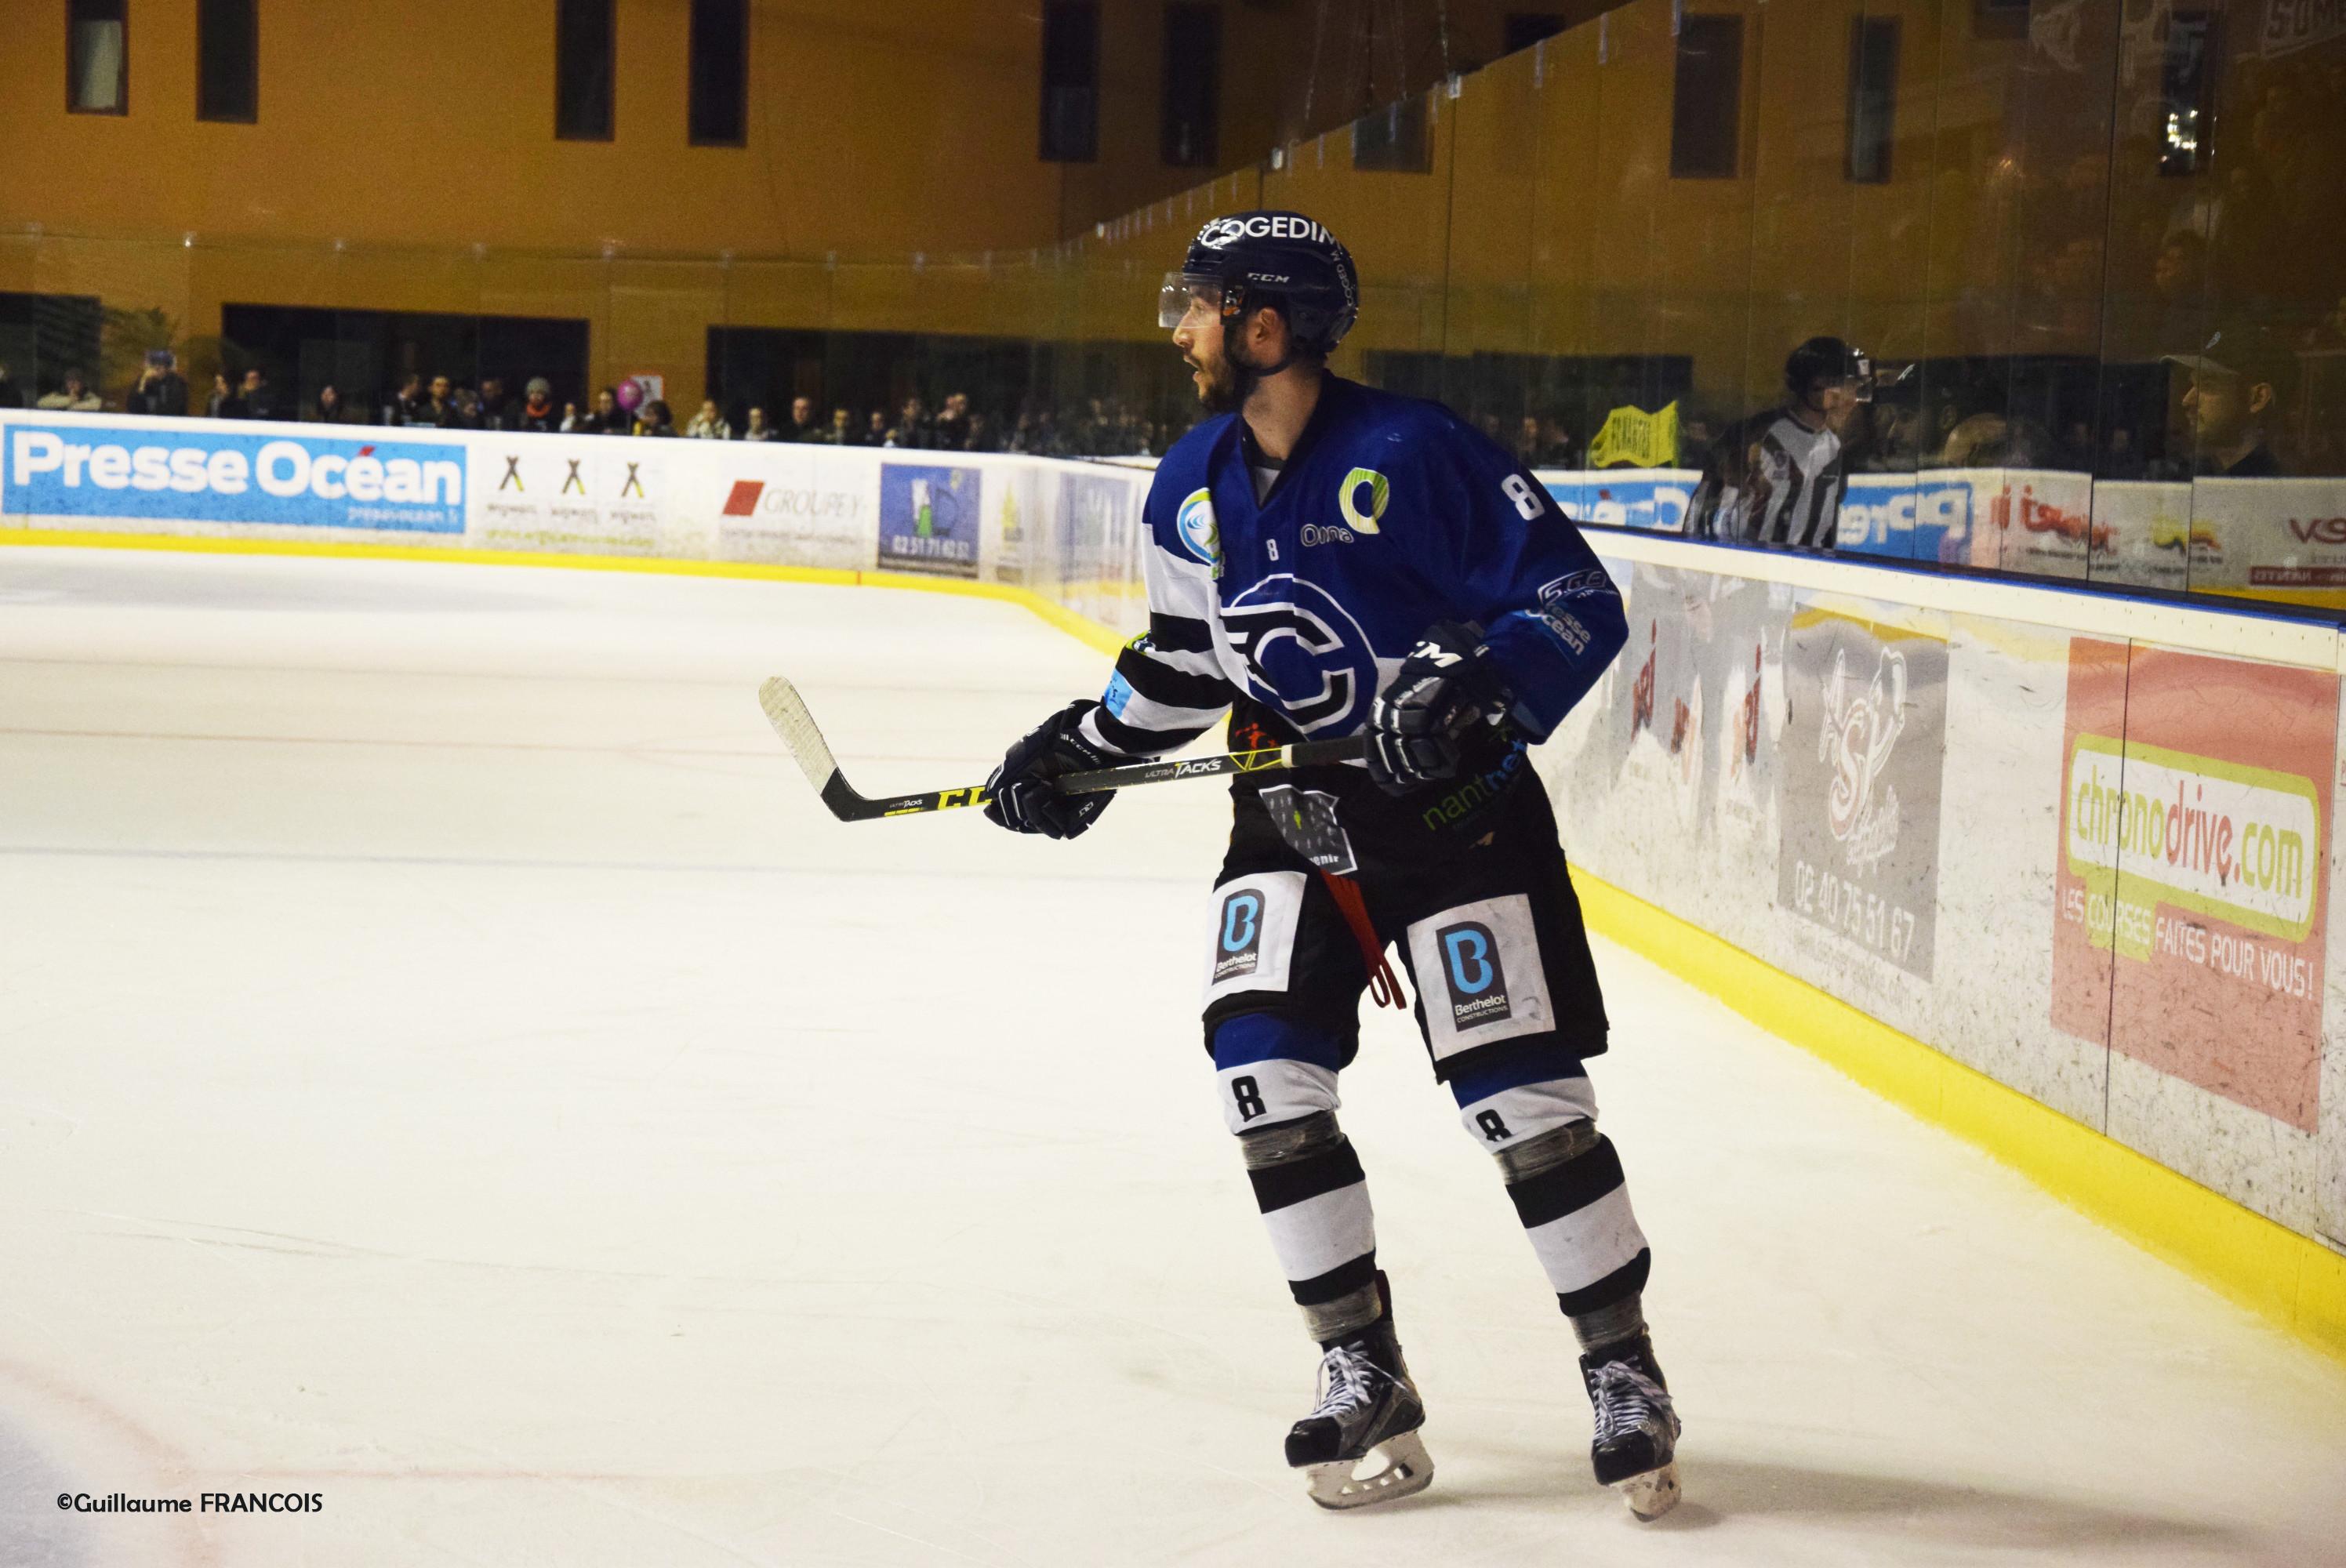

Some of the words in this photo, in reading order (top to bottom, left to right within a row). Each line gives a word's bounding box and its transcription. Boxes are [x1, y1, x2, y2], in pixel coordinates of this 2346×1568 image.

[1247, 273, 1291, 283] CCM
[13, 430, 249, 494] Presse
[256, 440, 462, 504] Océan
[1501, 473, 1545, 521] 8
[1266, 539, 1280, 561] 8
[1145, 769, 1174, 779] ULTRA
[1175, 758, 1222, 779] TACKS
[937, 786, 993, 811] CC
[2077, 764, 2304, 899] chronodrive.com
[1796, 860, 1814, 915] 02
[1819, 872, 1839, 924] 40
[1843, 880, 1862, 937] 75
[1866, 893, 1885, 948] 51
[1891, 906, 1915, 963] 67
[2063, 888, 2085, 924] LES
[2088, 893, 2152, 946] COURSES
[2155, 916, 2206, 965] FAITES
[2211, 934, 2254, 981] POUR
[1217, 952, 1257, 973] Berthelot
[1454, 995, 1506, 1016] Berthelot
[1231, 1075, 1267, 1122] 8
[1475, 1109, 1513, 1143] 8
